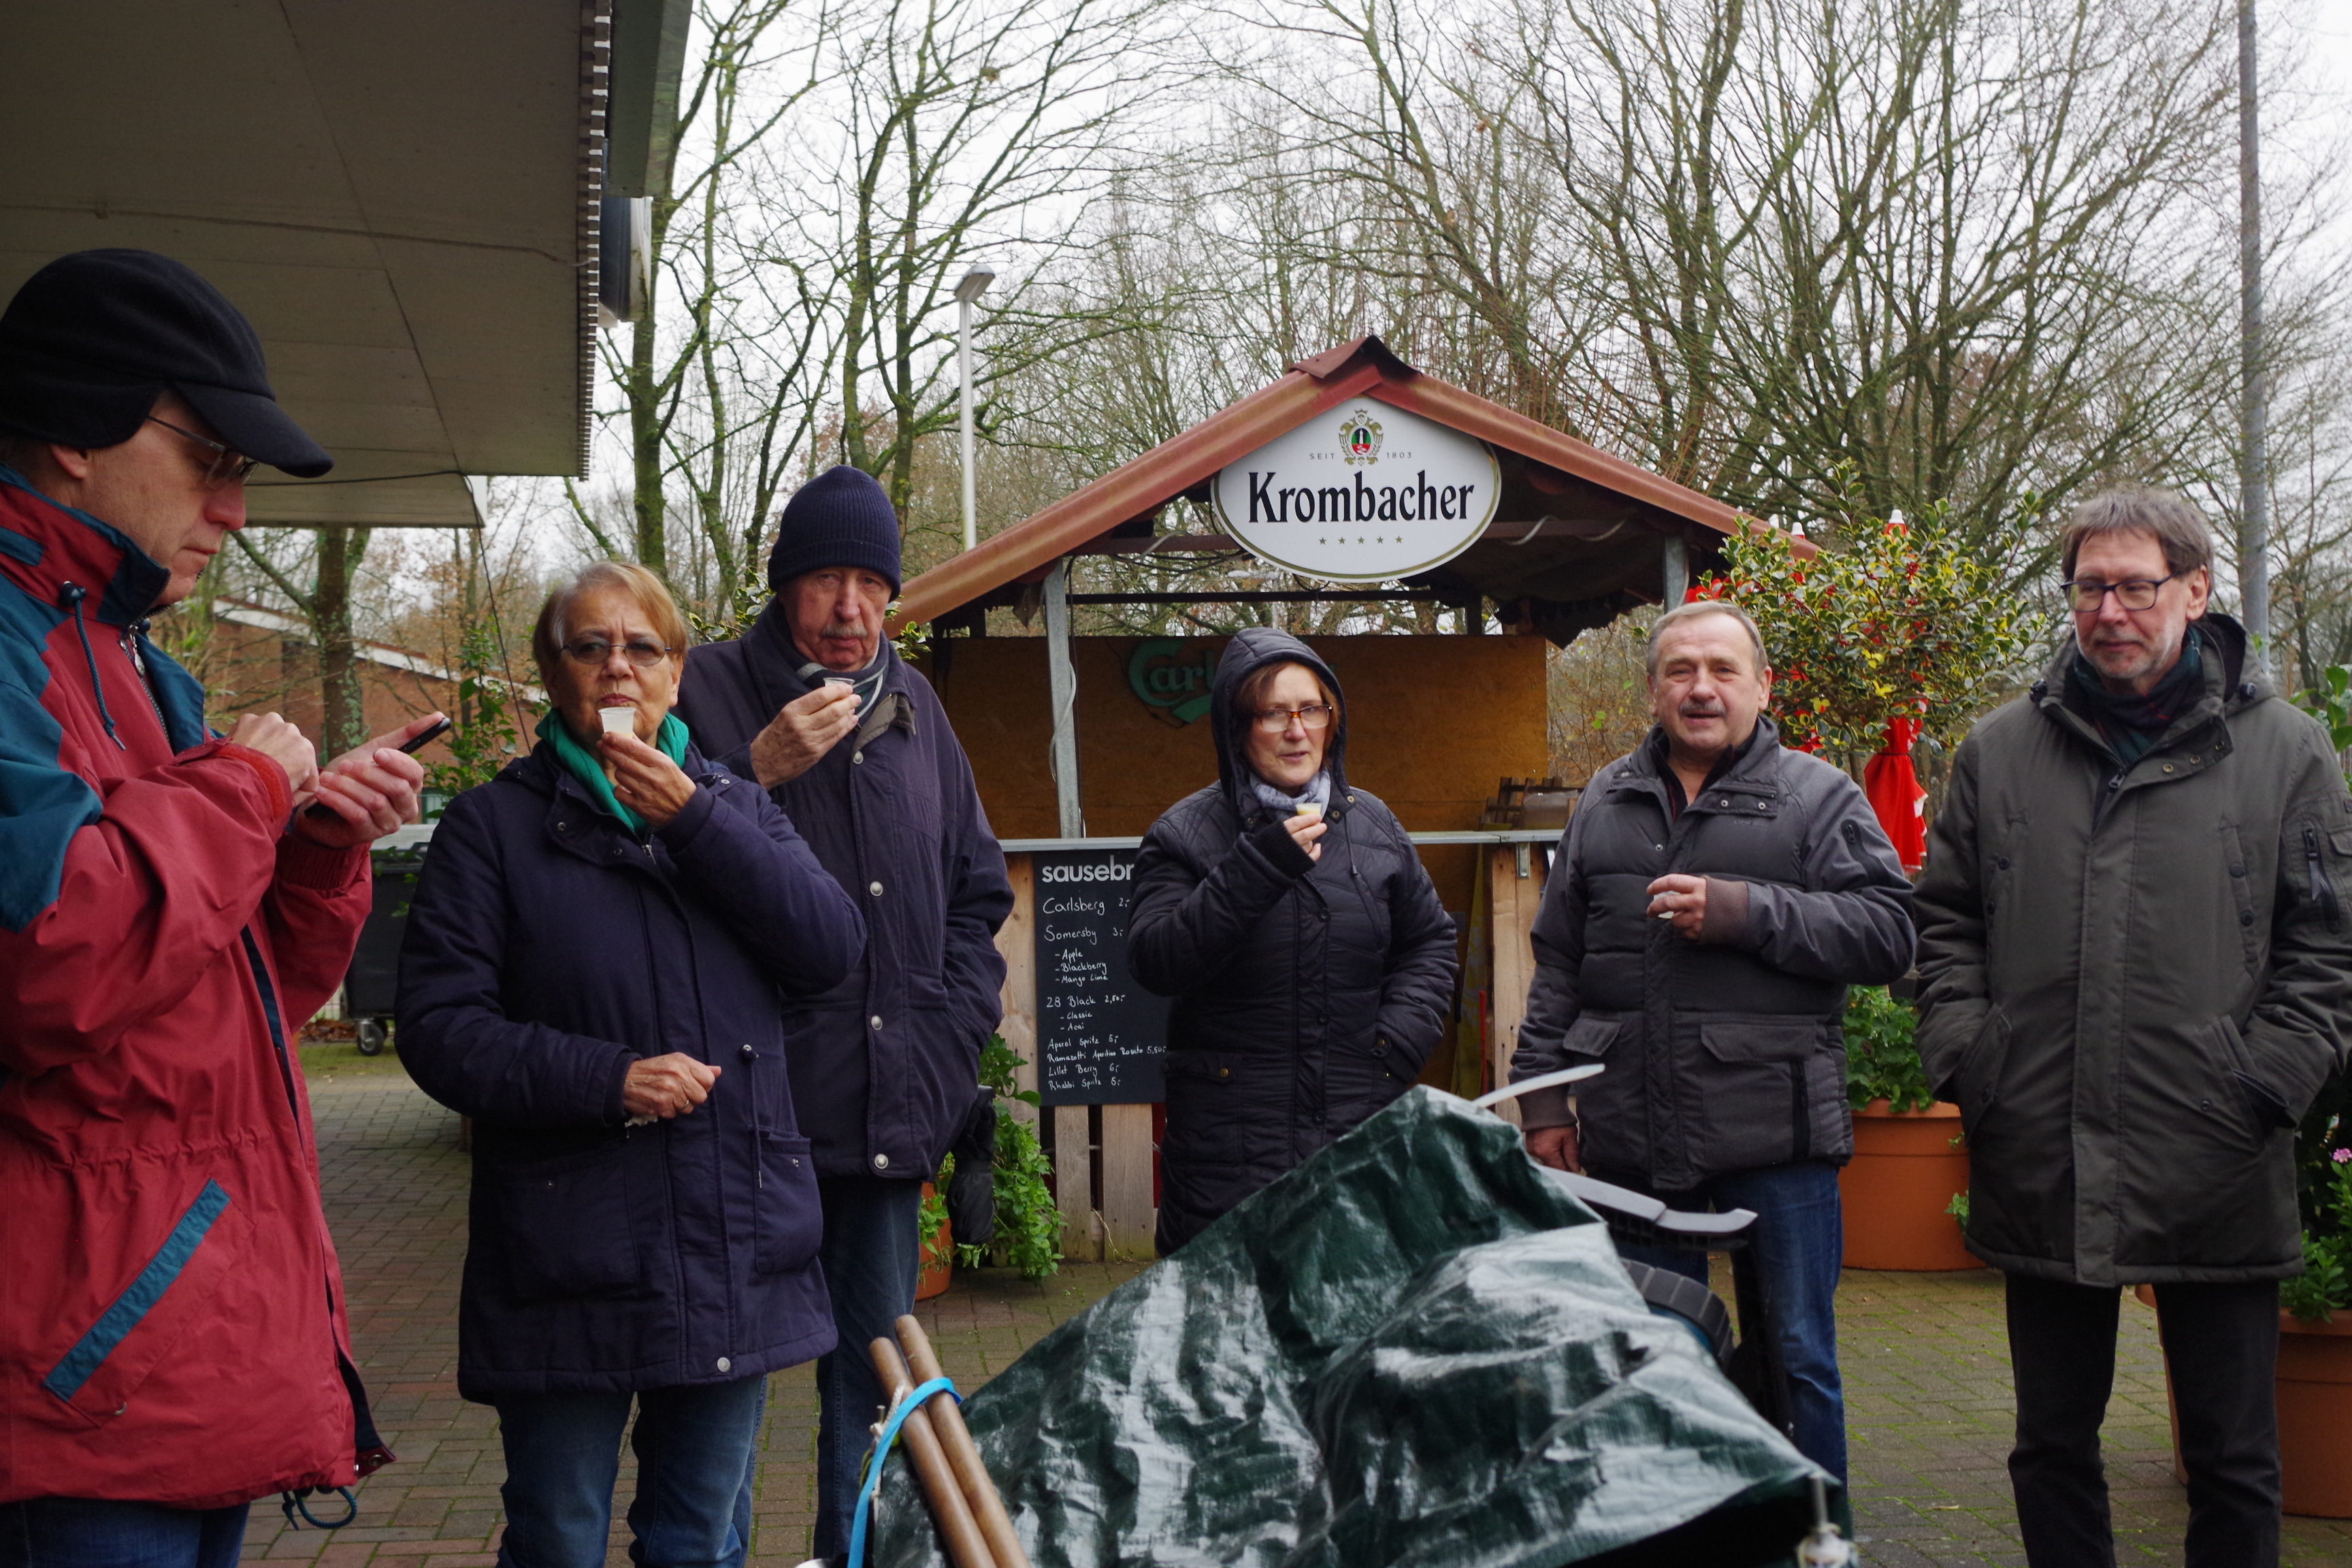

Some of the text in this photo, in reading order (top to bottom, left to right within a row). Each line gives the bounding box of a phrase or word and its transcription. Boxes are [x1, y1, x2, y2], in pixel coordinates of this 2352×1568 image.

[1249, 470, 1474, 523] Krombacher
[1043, 897, 1105, 915] Carlsberg
[1044, 925, 1097, 945] Somersby
[1047, 996, 1061, 1007] 28
[1067, 995, 1096, 1007] Black
[1047, 1038, 1072, 1052] Aperol
[1079, 1035, 1099, 1048] Spritz
[1049, 1065, 1068, 1077] Lillet
[1075, 1064, 1098, 1077] Berry
[1048, 1080, 1075, 1090] Rhabbi
[1081, 1077, 1102, 1090] Spritz
